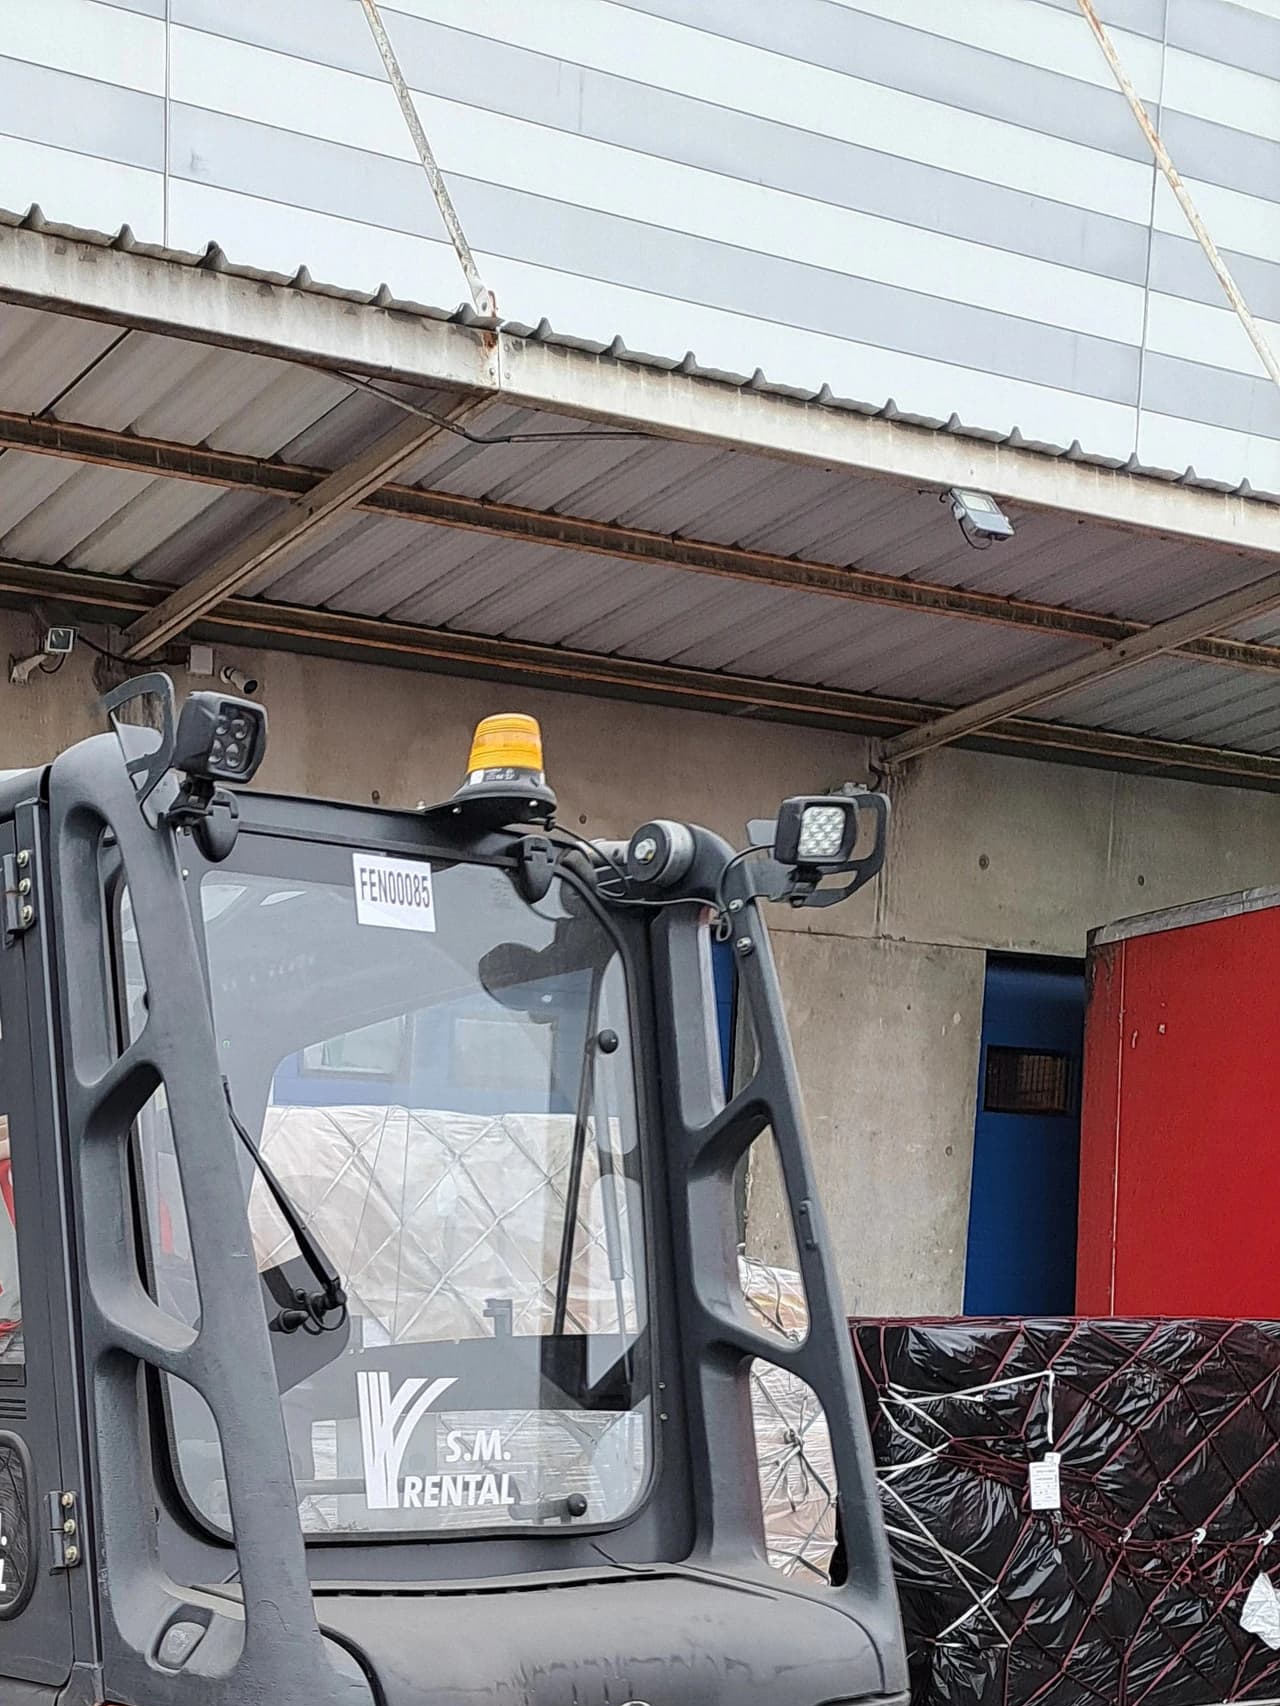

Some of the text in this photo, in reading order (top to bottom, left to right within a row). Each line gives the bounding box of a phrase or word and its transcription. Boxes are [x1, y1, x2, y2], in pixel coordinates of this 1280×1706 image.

[360, 867, 430, 909] FEN00085
[445, 1429, 512, 1462] S.M.
[402, 1473, 516, 1509] RENTAL
